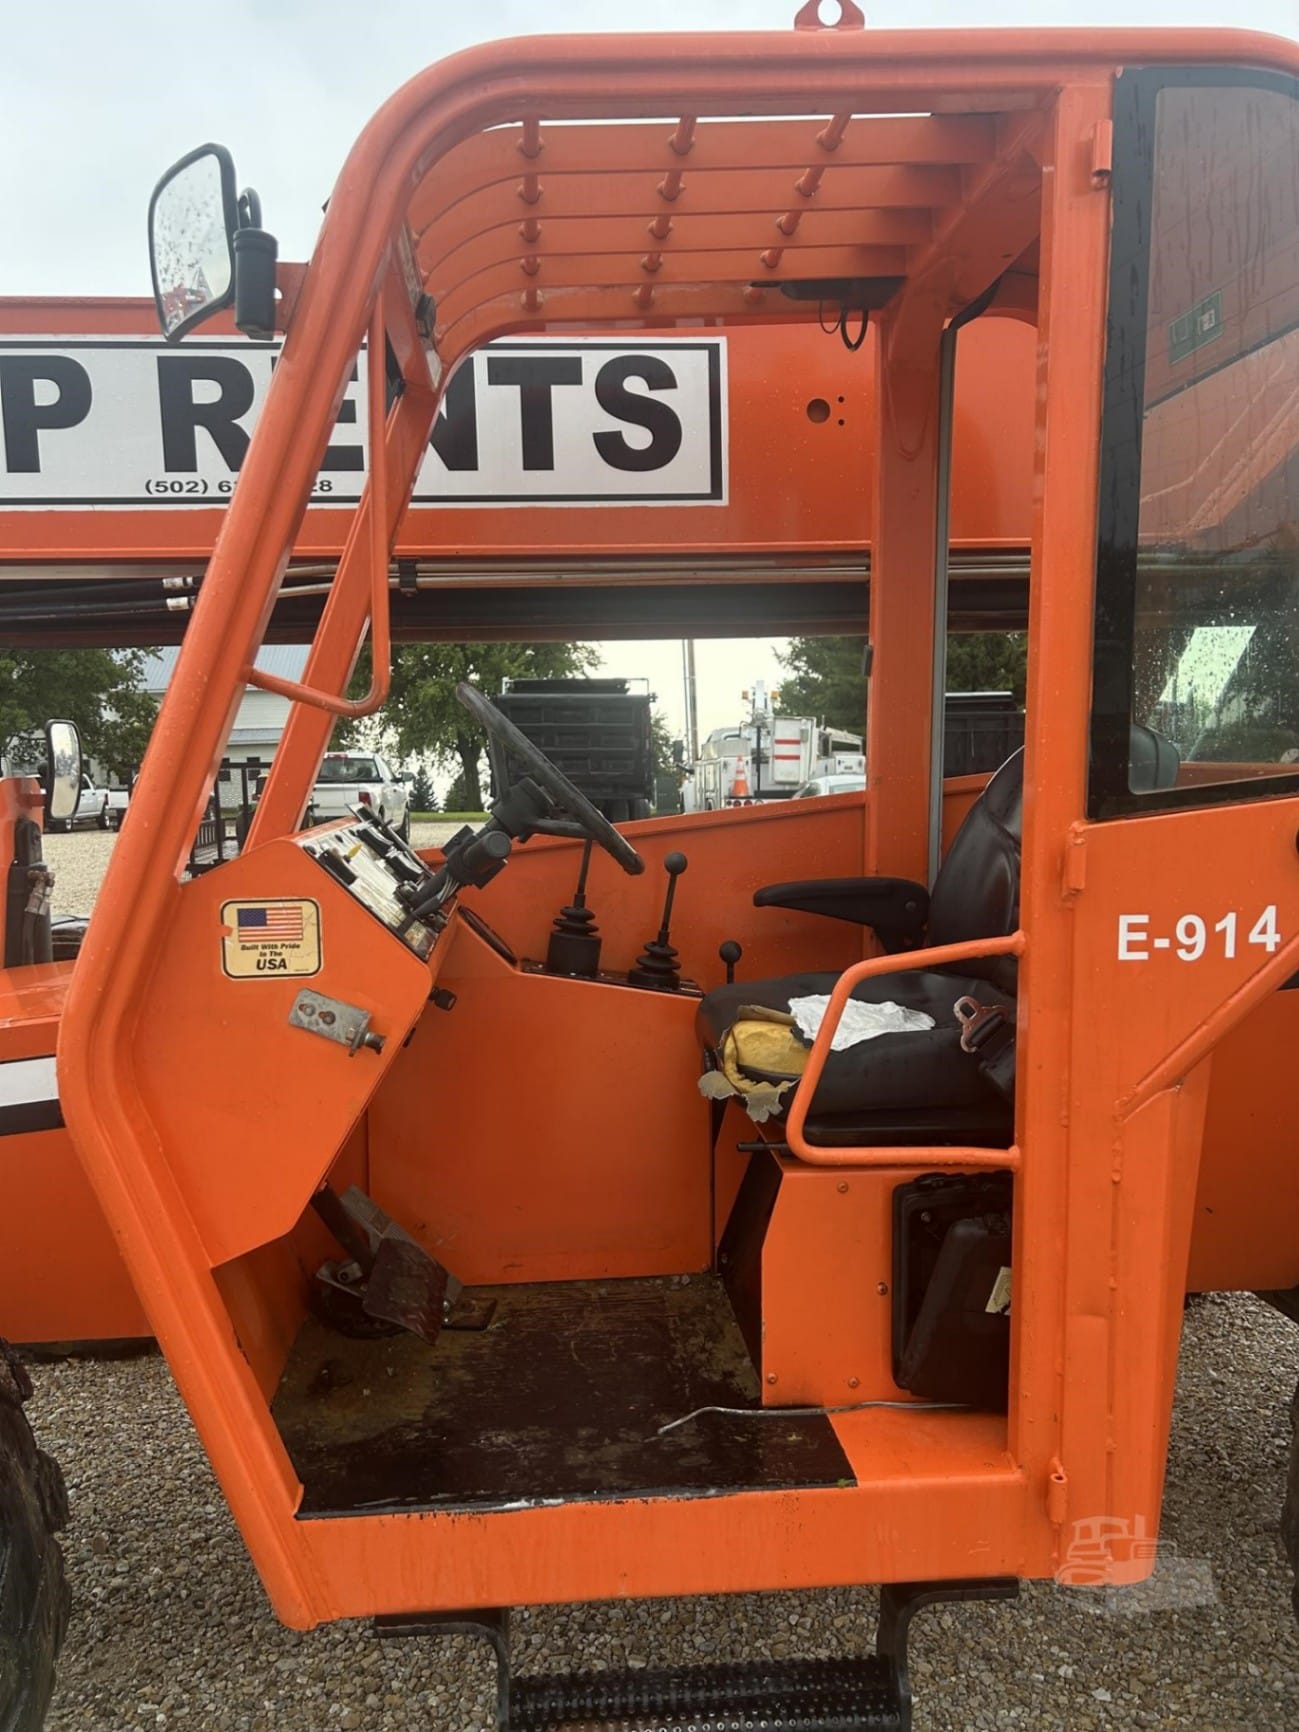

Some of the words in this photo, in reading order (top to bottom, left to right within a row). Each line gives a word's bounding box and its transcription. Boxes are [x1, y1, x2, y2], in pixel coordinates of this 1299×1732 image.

[145, 479, 209, 495] (502)
[1118, 905, 1281, 961] E-914
[256, 958, 287, 970] USA
